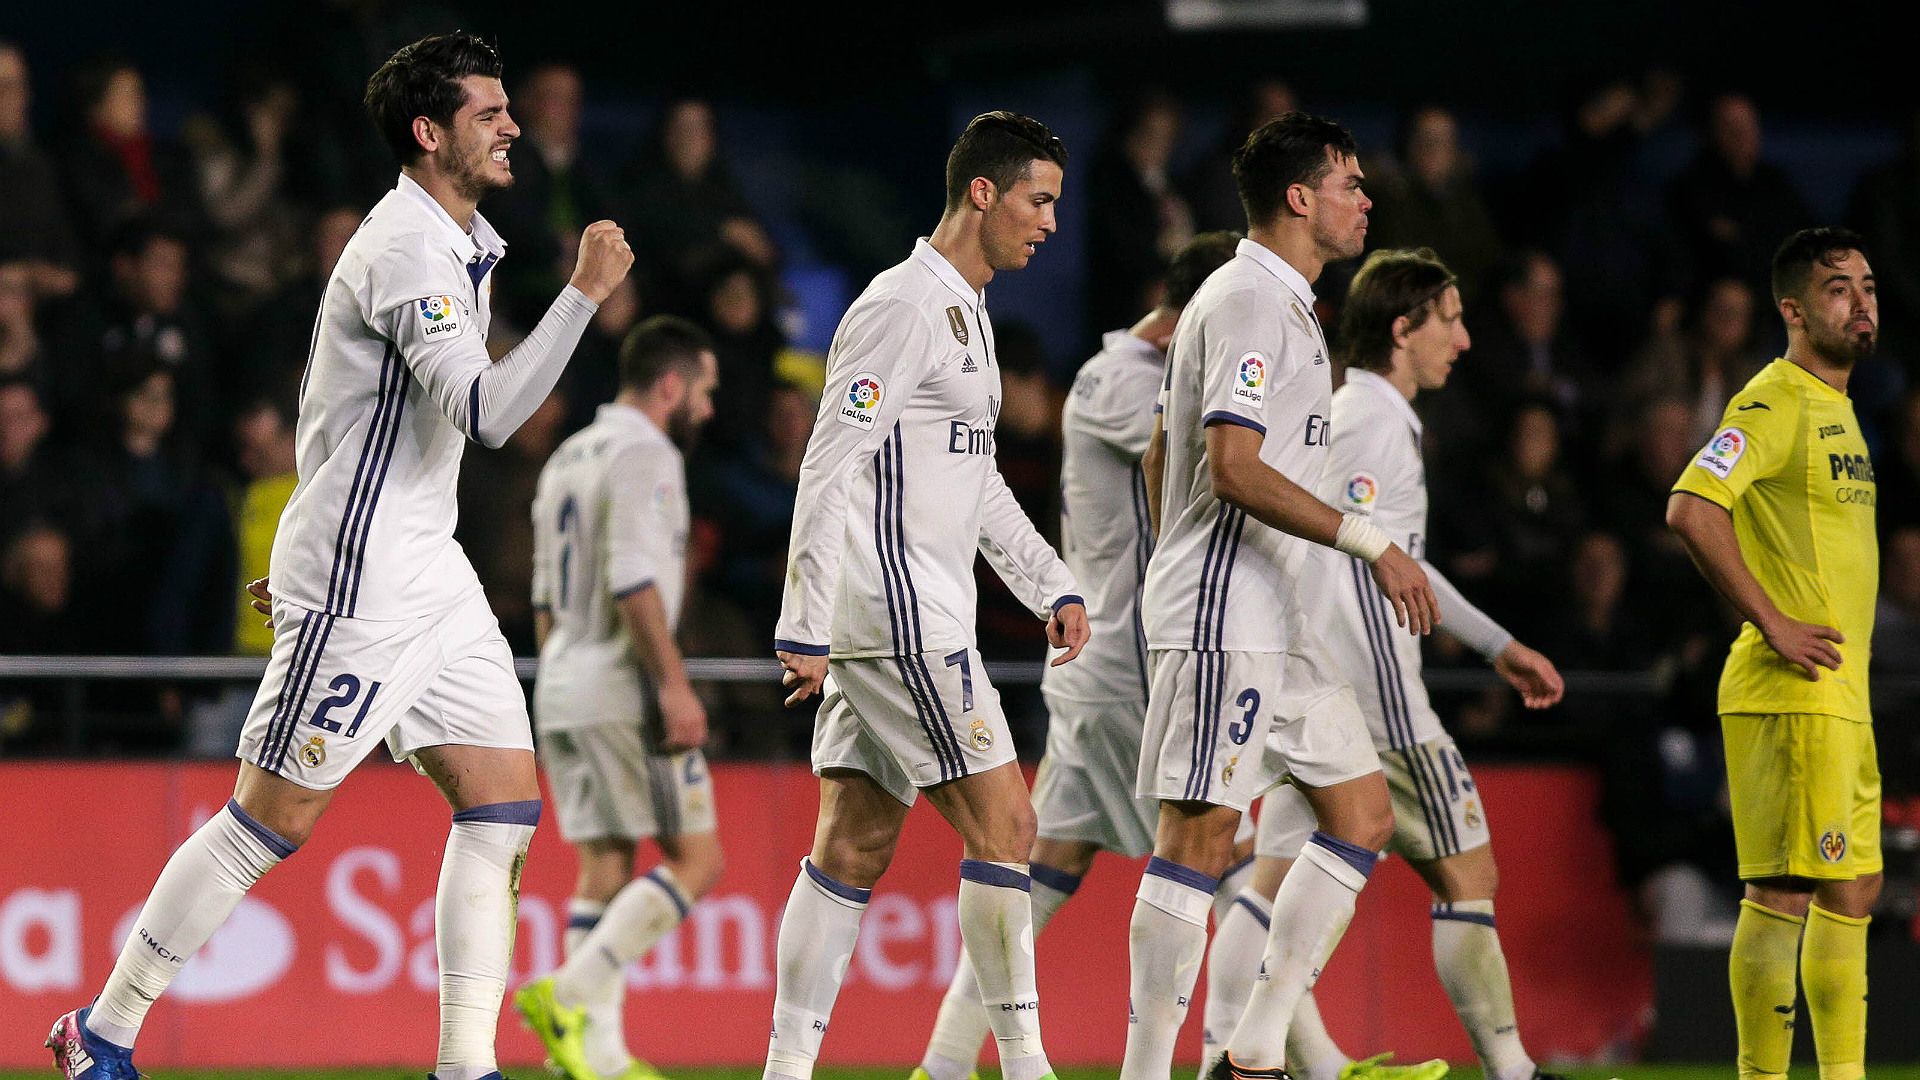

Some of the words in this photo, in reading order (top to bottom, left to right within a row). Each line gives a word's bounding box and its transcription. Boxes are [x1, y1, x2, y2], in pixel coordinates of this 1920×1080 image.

[425, 322, 457, 336] LaLiga
[1234, 387, 1262, 402] LaLiga
[841, 406, 873, 424] LaLiga
[944, 651, 974, 713] 7
[308, 673, 382, 738] 21
[1228, 687, 1261, 746] 3
[139, 927, 183, 963] RMCF
